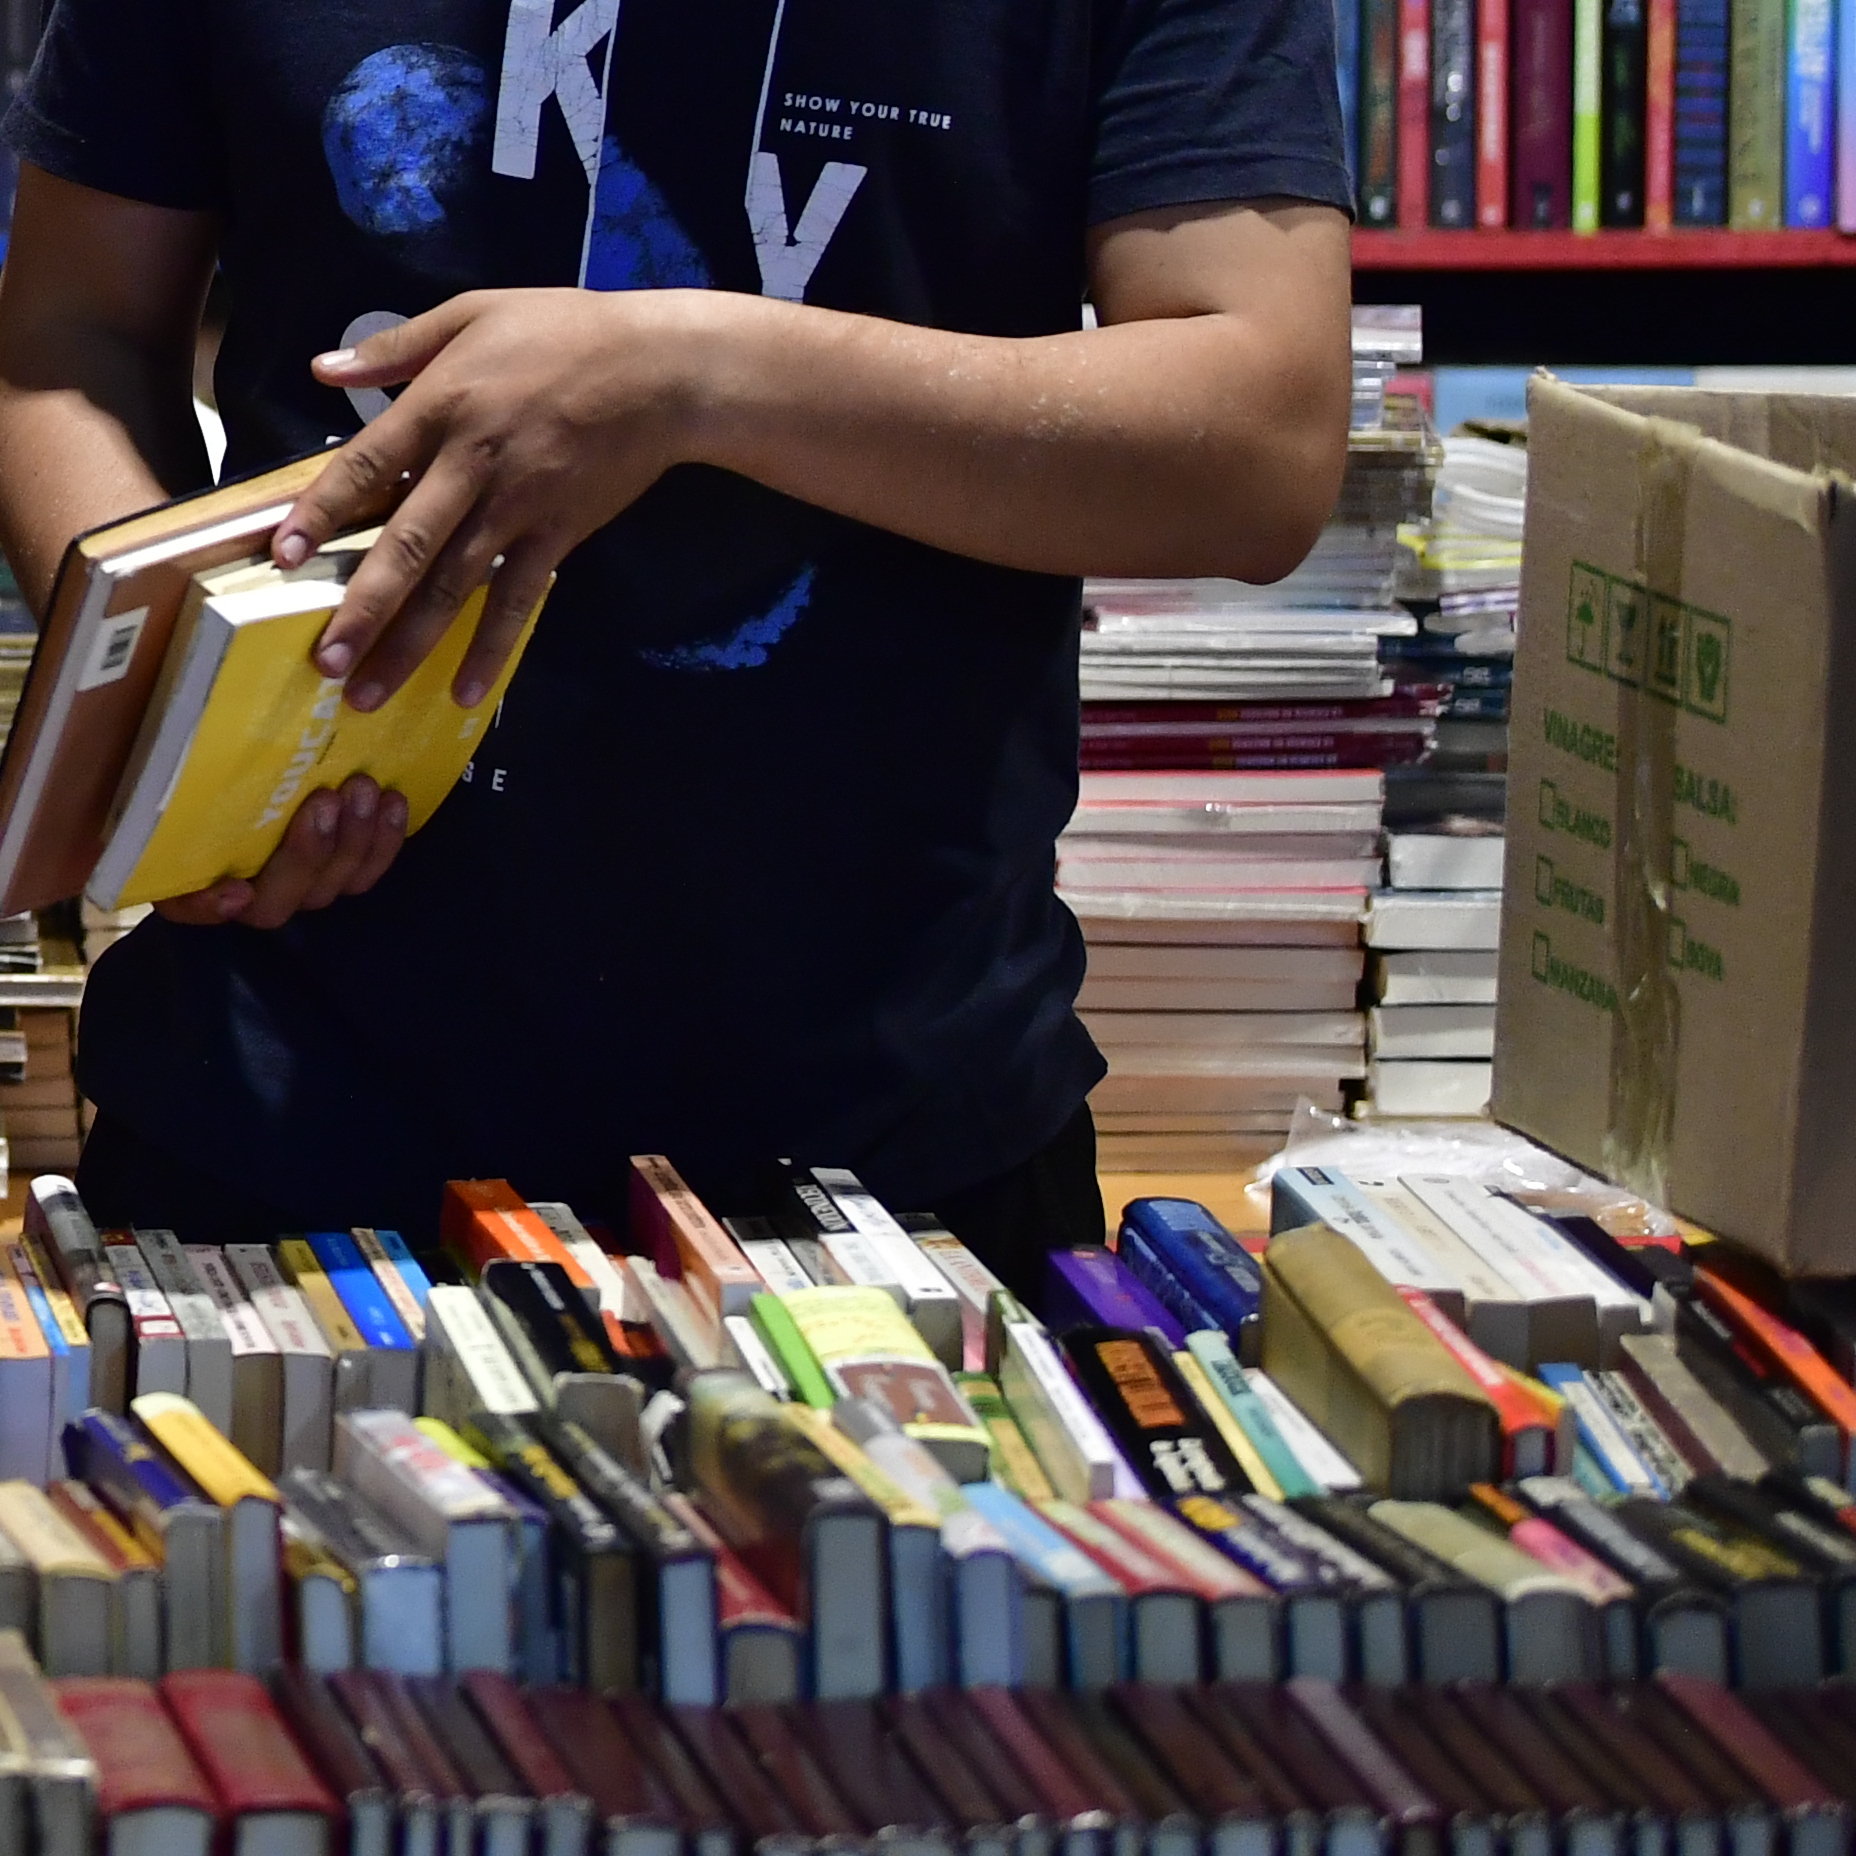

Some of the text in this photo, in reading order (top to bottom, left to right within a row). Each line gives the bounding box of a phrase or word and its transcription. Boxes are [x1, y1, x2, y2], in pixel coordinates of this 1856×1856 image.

[780, 118, 854, 141] NATURE
[784, 92, 952, 130] SHOW YOUR TRUE
[1552, 797, 1612, 850] BLANCO
[1553, 876, 1606, 925] FRUTAS
[1547, 954, 1620, 1012] MANZANA
